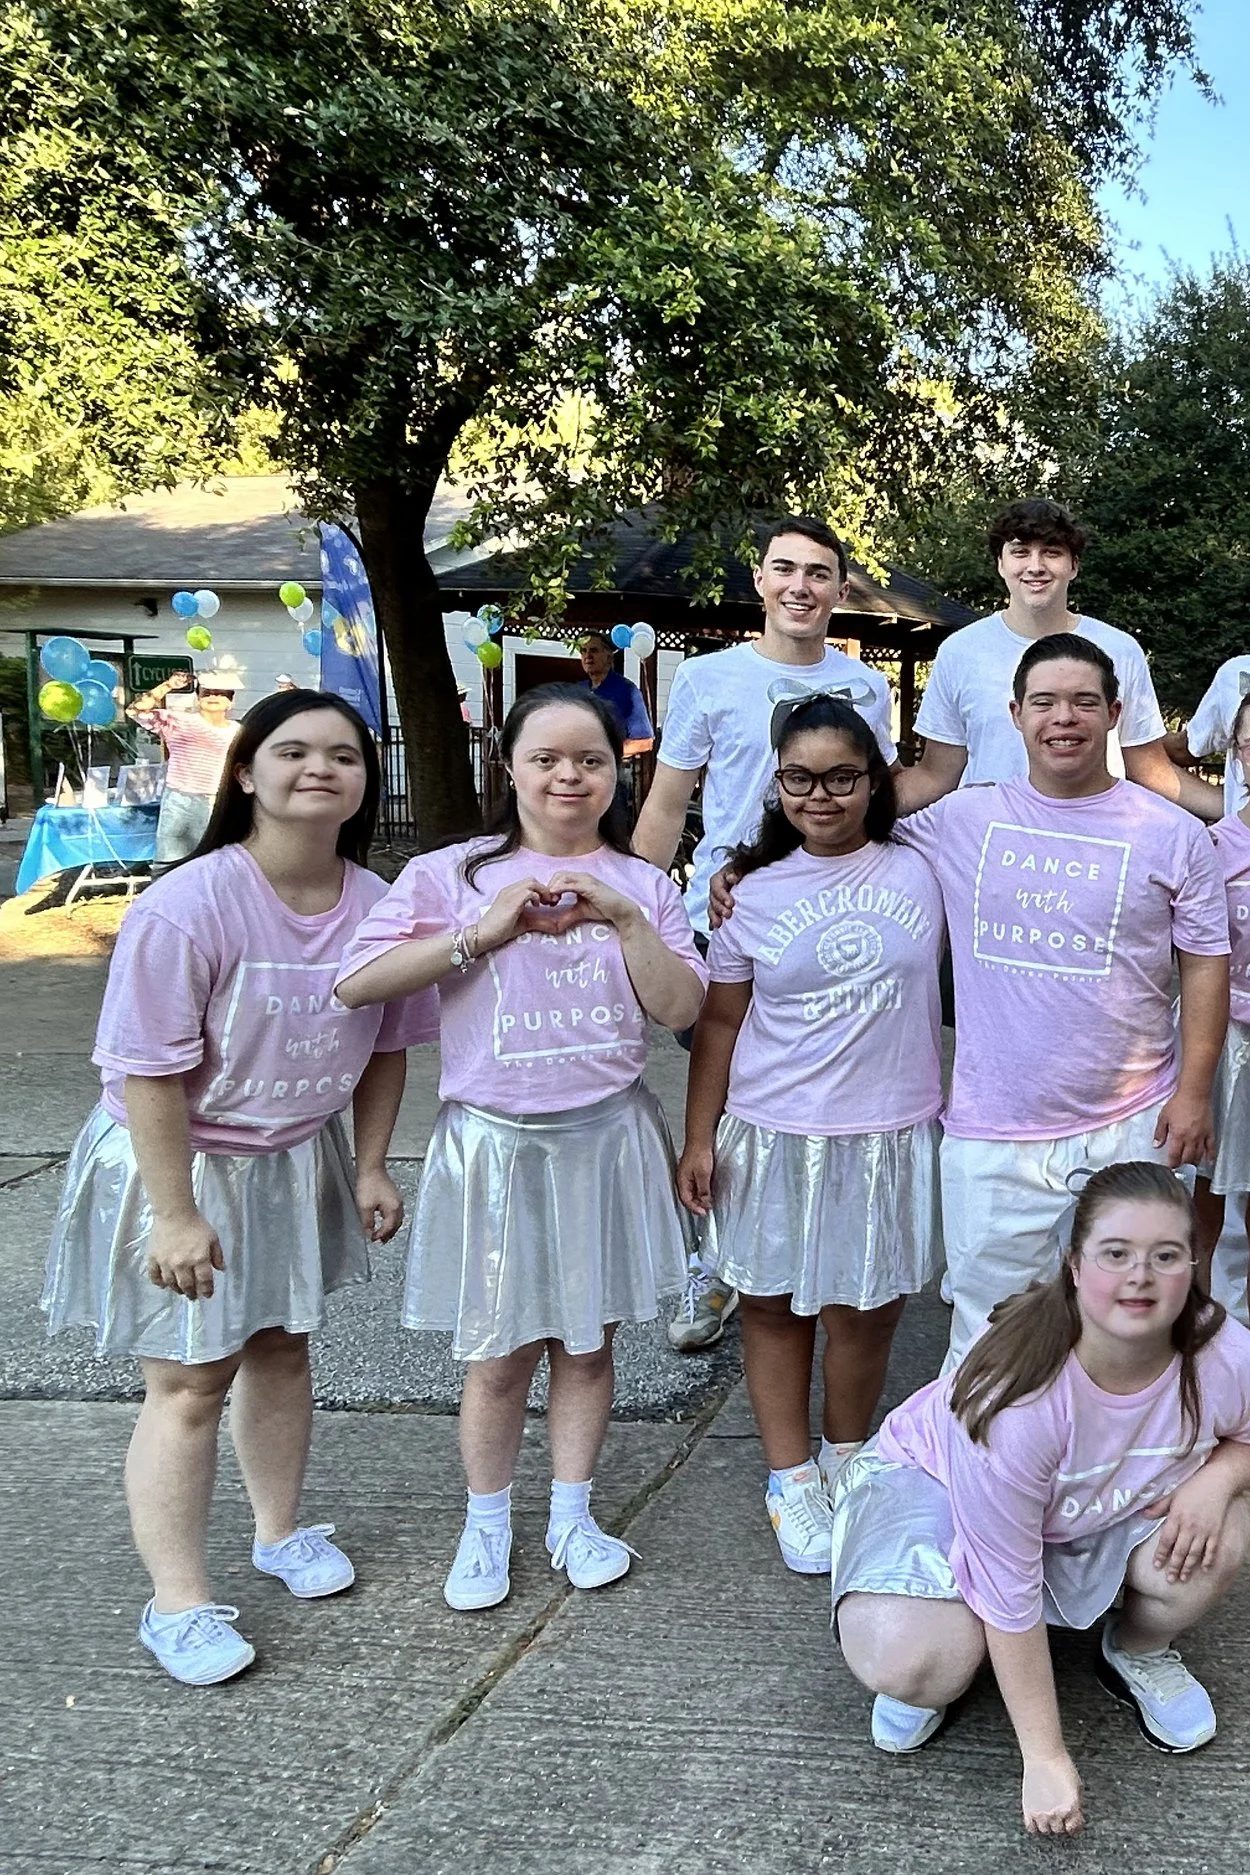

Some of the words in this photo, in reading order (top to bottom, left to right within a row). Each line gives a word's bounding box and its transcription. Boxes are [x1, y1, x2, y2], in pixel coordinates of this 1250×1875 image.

[1001, 849, 1100, 881] DANCE
[1015, 888, 1073, 914] with
[979, 920, 1107, 954] PURPOSE
[544, 957, 611, 989] with
[266, 993, 368, 1016] DANC
[285, 1027, 341, 1060] with
[217, 1072, 354, 1100] PURPOS
